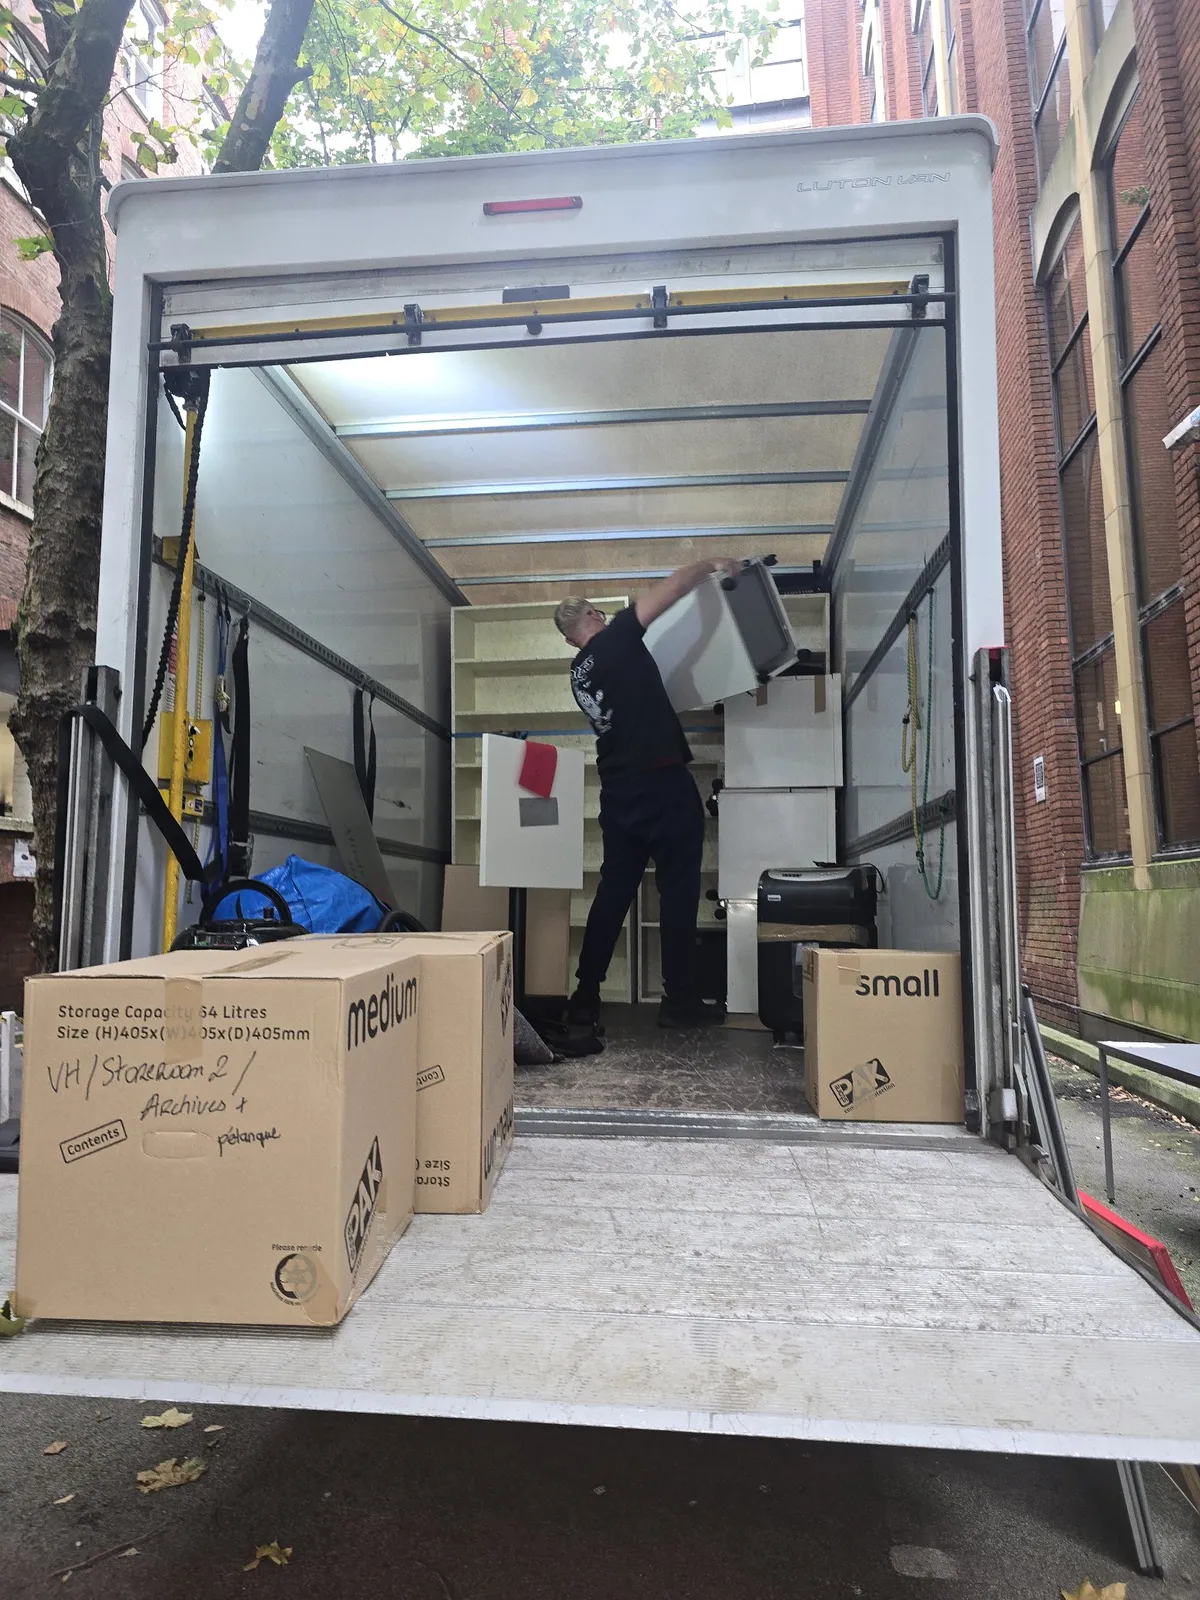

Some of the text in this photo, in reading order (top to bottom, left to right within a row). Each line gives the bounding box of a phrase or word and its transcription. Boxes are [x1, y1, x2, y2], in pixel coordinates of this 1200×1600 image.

[797, 173, 951, 192] LUTON VAN
[855, 969, 939, 997] small
[58, 1005, 268, 1021] Storage Capacity 64 Litres
[347, 971, 417, 1052] medium
[57, 1026, 89, 1039] Size
[831, 1059, 890, 1107] PAK
[66, 1128, 121, 1156] Contents
[424, 1160, 451, 1171] Size
[345, 1138, 383, 1268] PAK
[271, 1243, 296, 1252] Please
